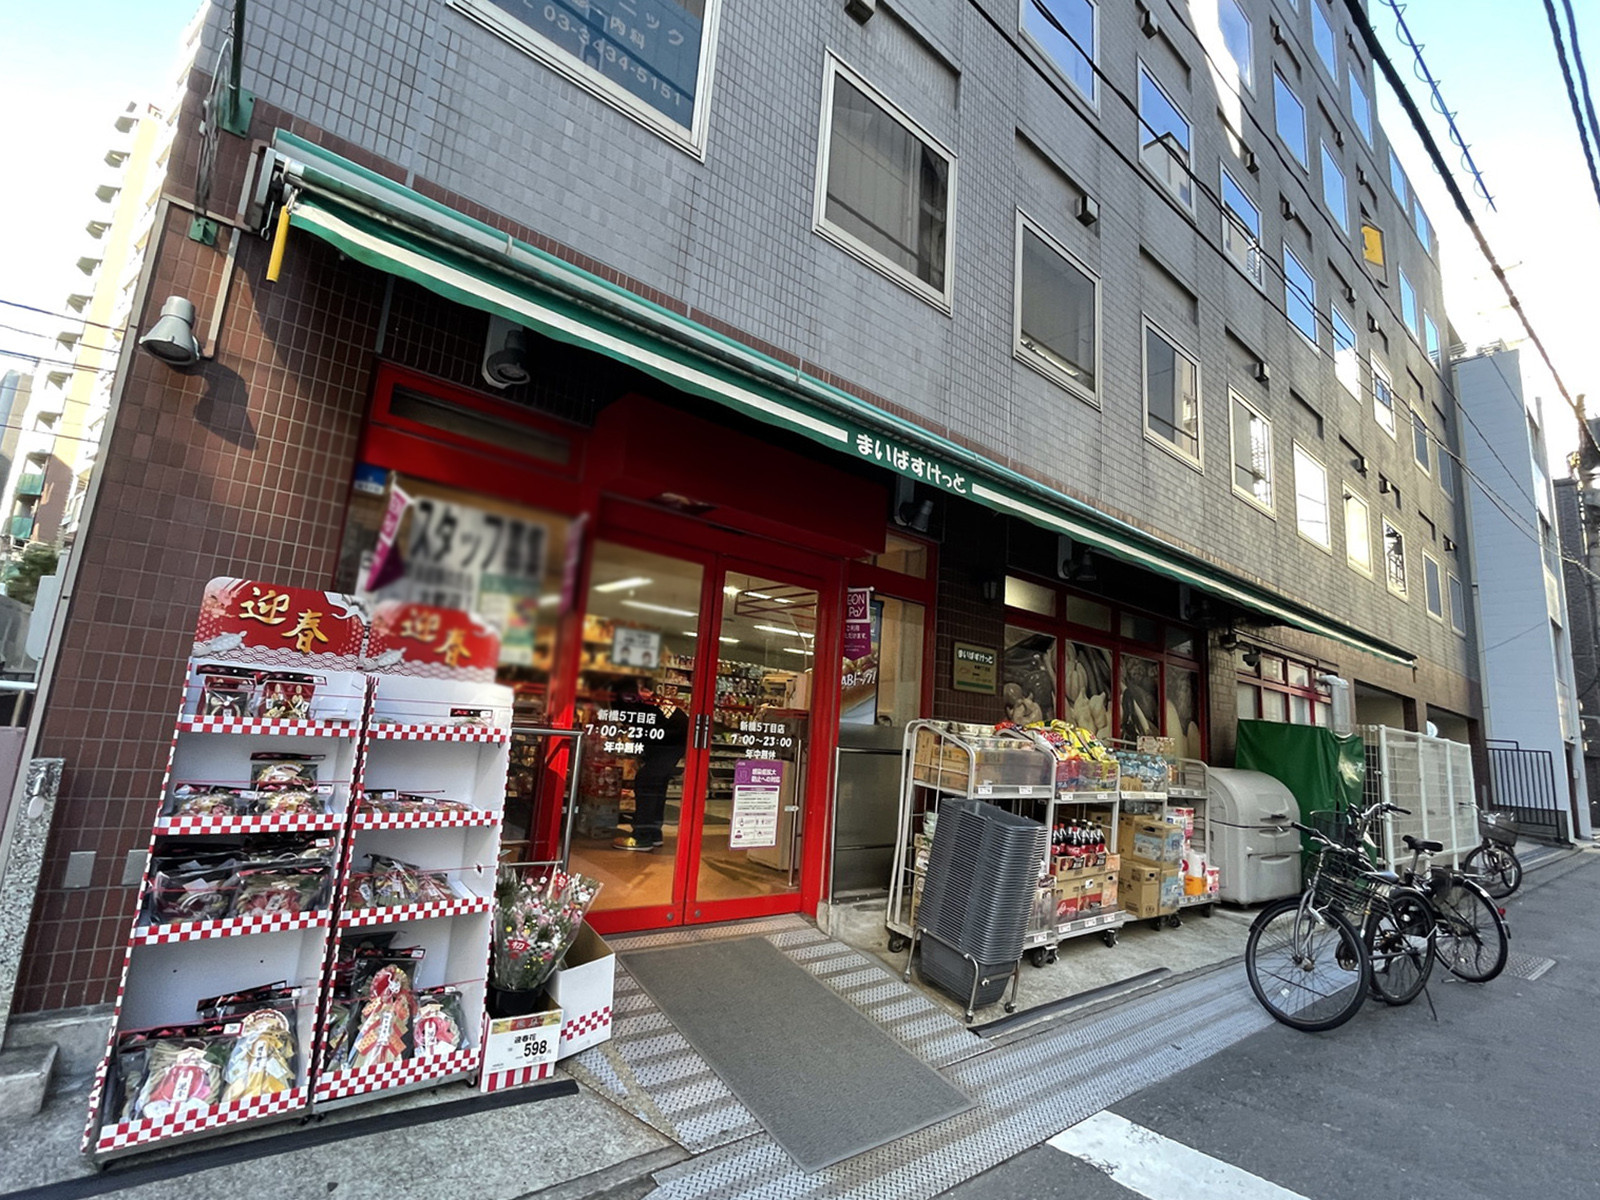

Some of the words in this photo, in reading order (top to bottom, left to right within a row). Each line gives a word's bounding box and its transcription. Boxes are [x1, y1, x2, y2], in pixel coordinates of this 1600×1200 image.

[543, 5, 681, 106] 03-3434-5151
[856, 433, 967, 494] まいばすけっと
[847, 593, 865, 606] EON
[239, 586, 329, 654] 迎春
[597, 708, 657, 725] 新橋5丁目店
[523, 1039, 548, 1057] 598
